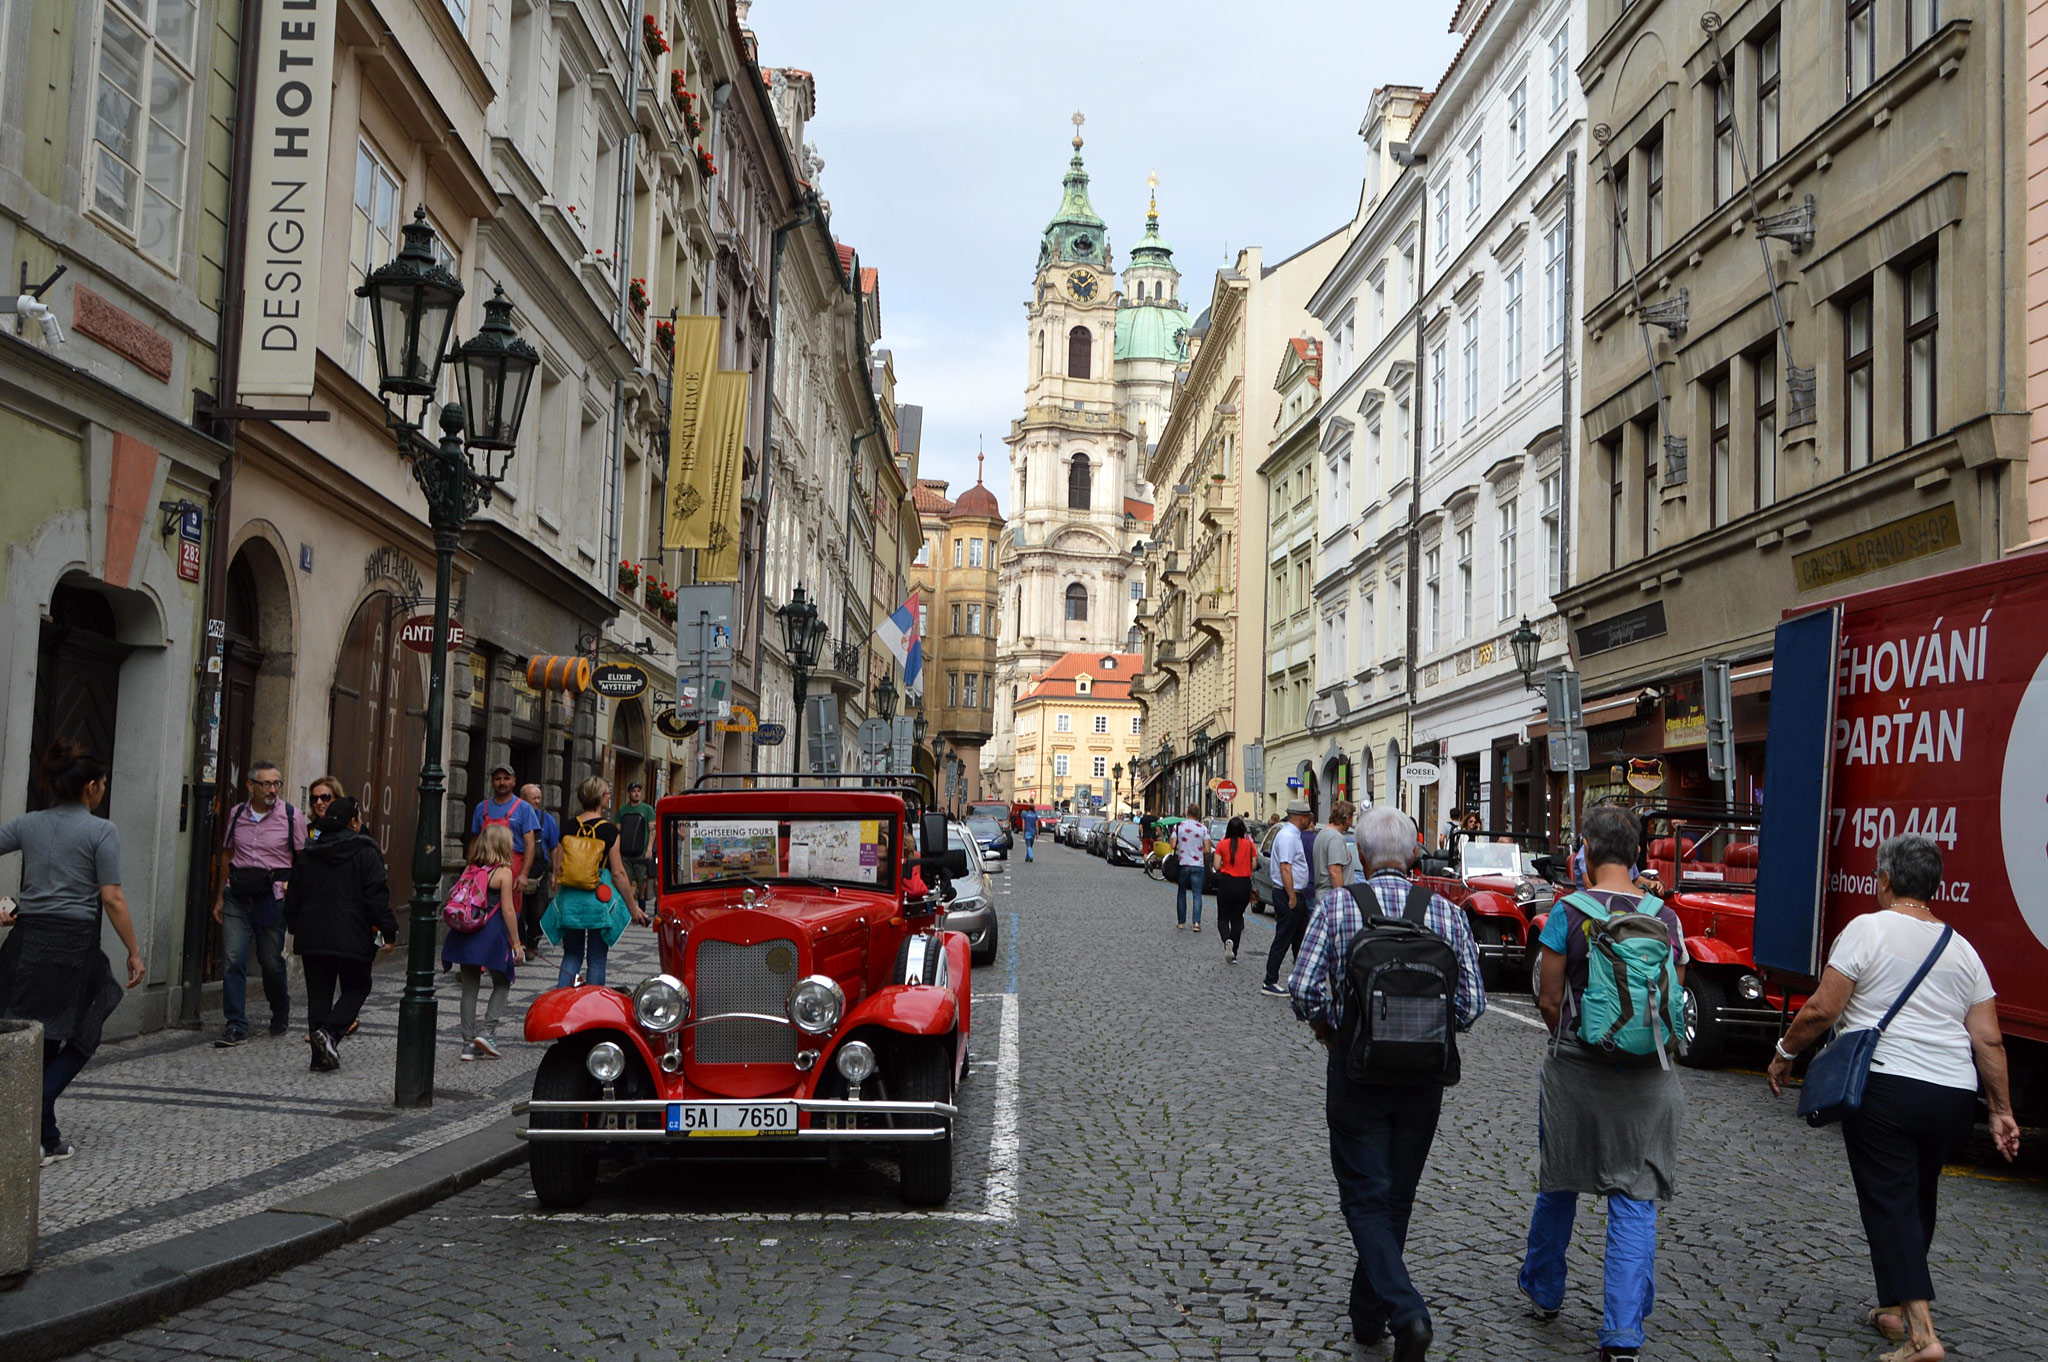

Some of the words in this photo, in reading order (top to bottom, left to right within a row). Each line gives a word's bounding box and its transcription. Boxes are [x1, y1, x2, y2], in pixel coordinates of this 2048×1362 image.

[272, 0, 318, 158] HOTEL
[260, 181, 308, 352] DESIGN
[681, 371, 700, 472] RESTAURACE
[184, 544, 200, 564] 282
[1802, 544, 1856, 584] CRYSTAL
[1856, 529, 1905, 568] BRAND
[1907, 514, 1950, 550] SHOP
[364, 547, 424, 607] ANTIQUE
[601, 683, 637, 691] MYSTERY
[608, 673, 632, 681] ELIXIR
[1406, 768, 1436, 776] ROESEL
[693, 828, 746, 837] SIGHTSEEING
[748, 827, 774, 836] TOURS
[1851, 807, 1896, 849] 150
[1903, 806, 1958, 850] 444
[668, 1121, 679, 1129] CZ
[738, 1108, 788, 1128] 7650
